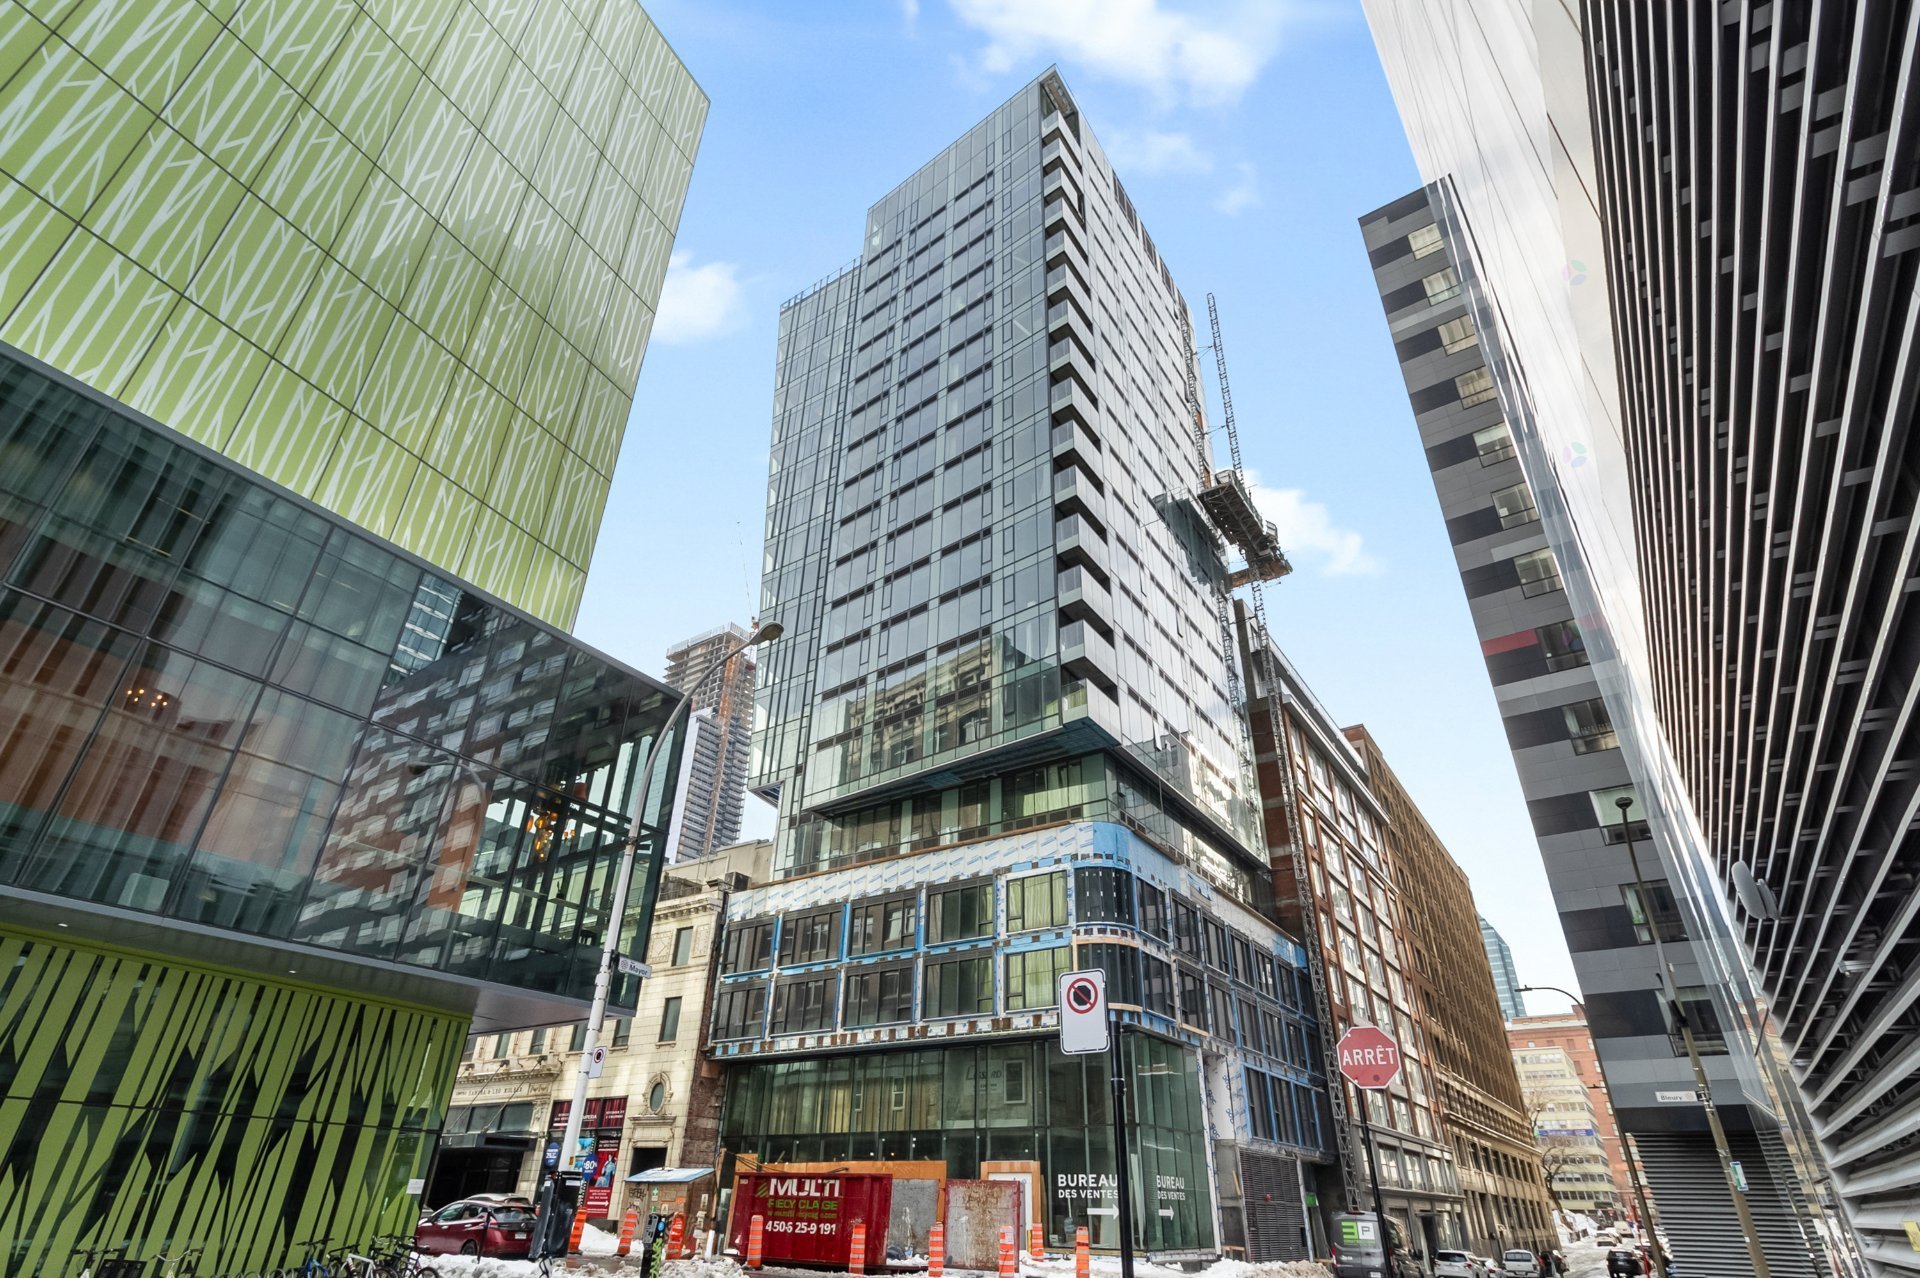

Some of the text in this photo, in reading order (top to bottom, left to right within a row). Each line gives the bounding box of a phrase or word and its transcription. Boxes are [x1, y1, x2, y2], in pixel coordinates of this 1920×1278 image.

[629, 964, 648, 976] Mayor
[1343, 1045, 1394, 1066] ARRÊT
[1057, 1173, 1118, 1187] BUREAU
[1156, 1174, 1185, 1189] BUREAU
[769, 1178, 840, 1197] MULTI
[1058, 1190, 1119, 1199] DES VENTES
[1157, 1191, 1186, 1201] DES VENTES
